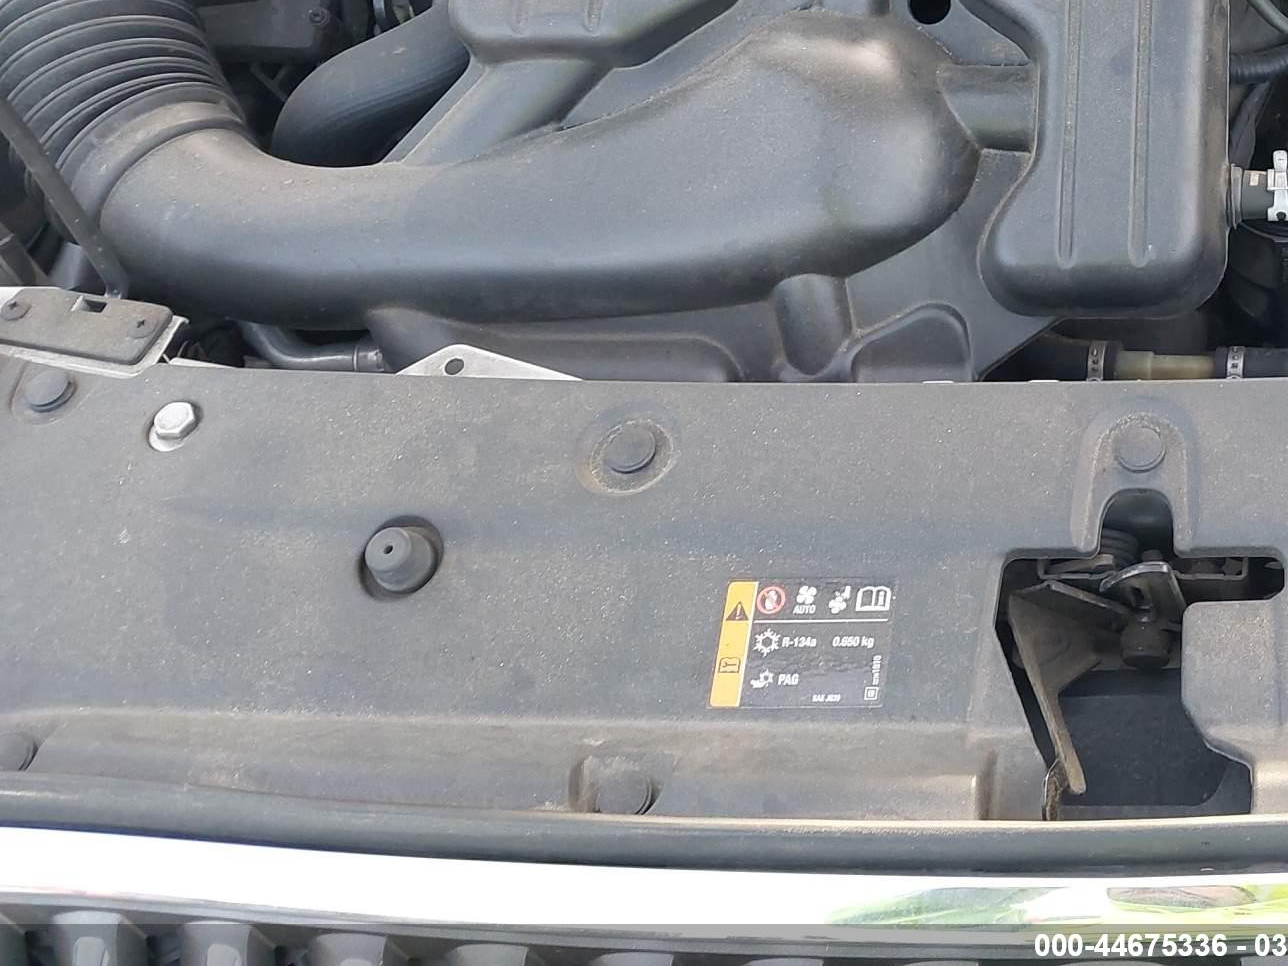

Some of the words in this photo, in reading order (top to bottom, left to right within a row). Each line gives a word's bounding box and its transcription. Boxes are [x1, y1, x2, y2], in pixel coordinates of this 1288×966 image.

[793, 604, 816, 615] AUTO
[781, 636, 817, 647] R-134a
[861, 636, 875, 649] kg
[777, 673, 800, 686] PAG
